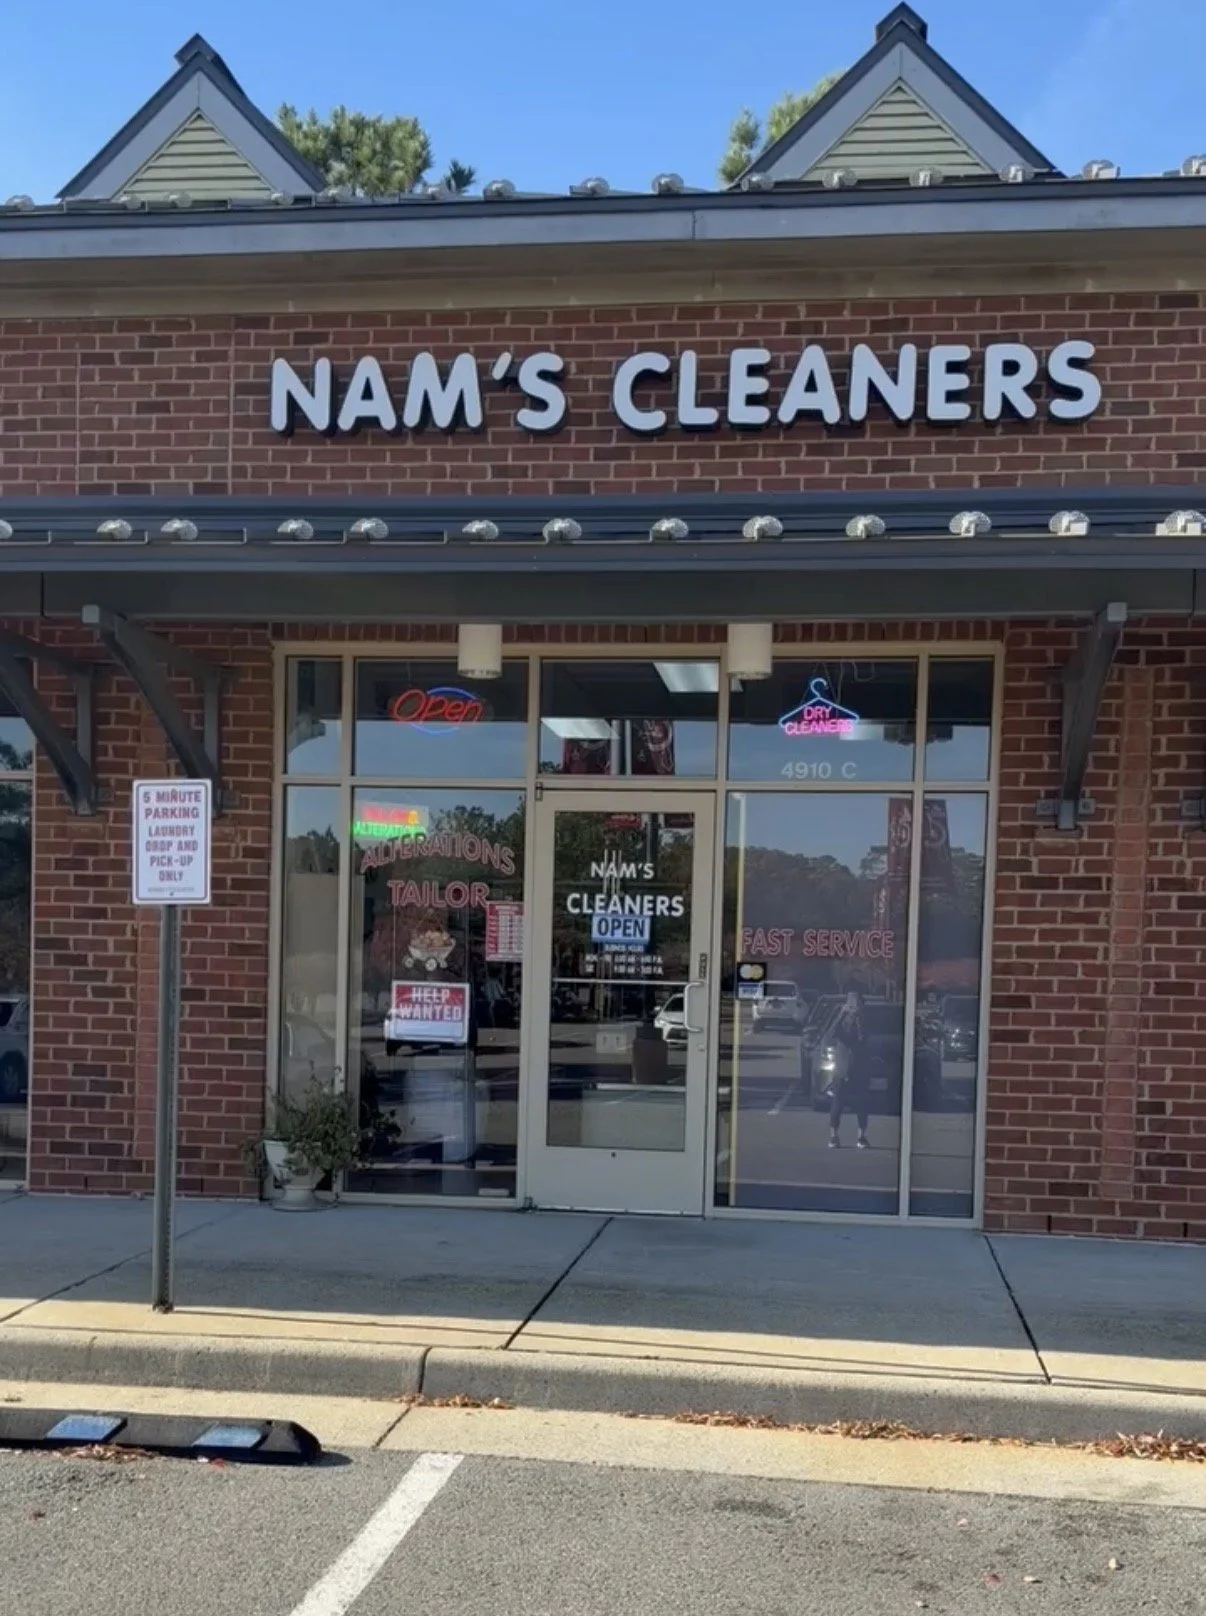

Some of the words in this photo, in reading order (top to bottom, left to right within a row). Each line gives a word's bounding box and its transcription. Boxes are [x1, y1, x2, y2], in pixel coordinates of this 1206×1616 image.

[271, 350, 566, 433] NAM'S
[613, 340, 1103, 433] CLEANERS
[393, 689, 483, 724] Open
[803, 706, 832, 720] DRY
[784, 719, 854, 735] CLEANERS
[781, 761, 832, 779] 4910
[841, 761, 857, 779] C
[143, 791, 151, 803] 5
[156, 789, 202, 803] MINUTE
[144, 807, 200, 819] PARKING
[148, 825, 195, 837] LAUNDRY
[145, 840, 173, 852] DROP
[177, 840, 198, 852] AND
[360, 832, 516, 876] ALTERATIONS
[150, 855, 194, 867] PICK-UP
[590, 861, 654, 879] NAM'S
[159, 870, 184, 882] ONLY
[387, 879, 490, 908] TAILOR
[567, 893, 684, 917] CLEANERS
[597, 918, 645, 938] OPEN
[742, 927, 795, 956] FAST
[802, 928, 895, 959] SERVICE
[411, 986, 450, 1004] HELP
[399, 1003, 462, 1021] WANTED
